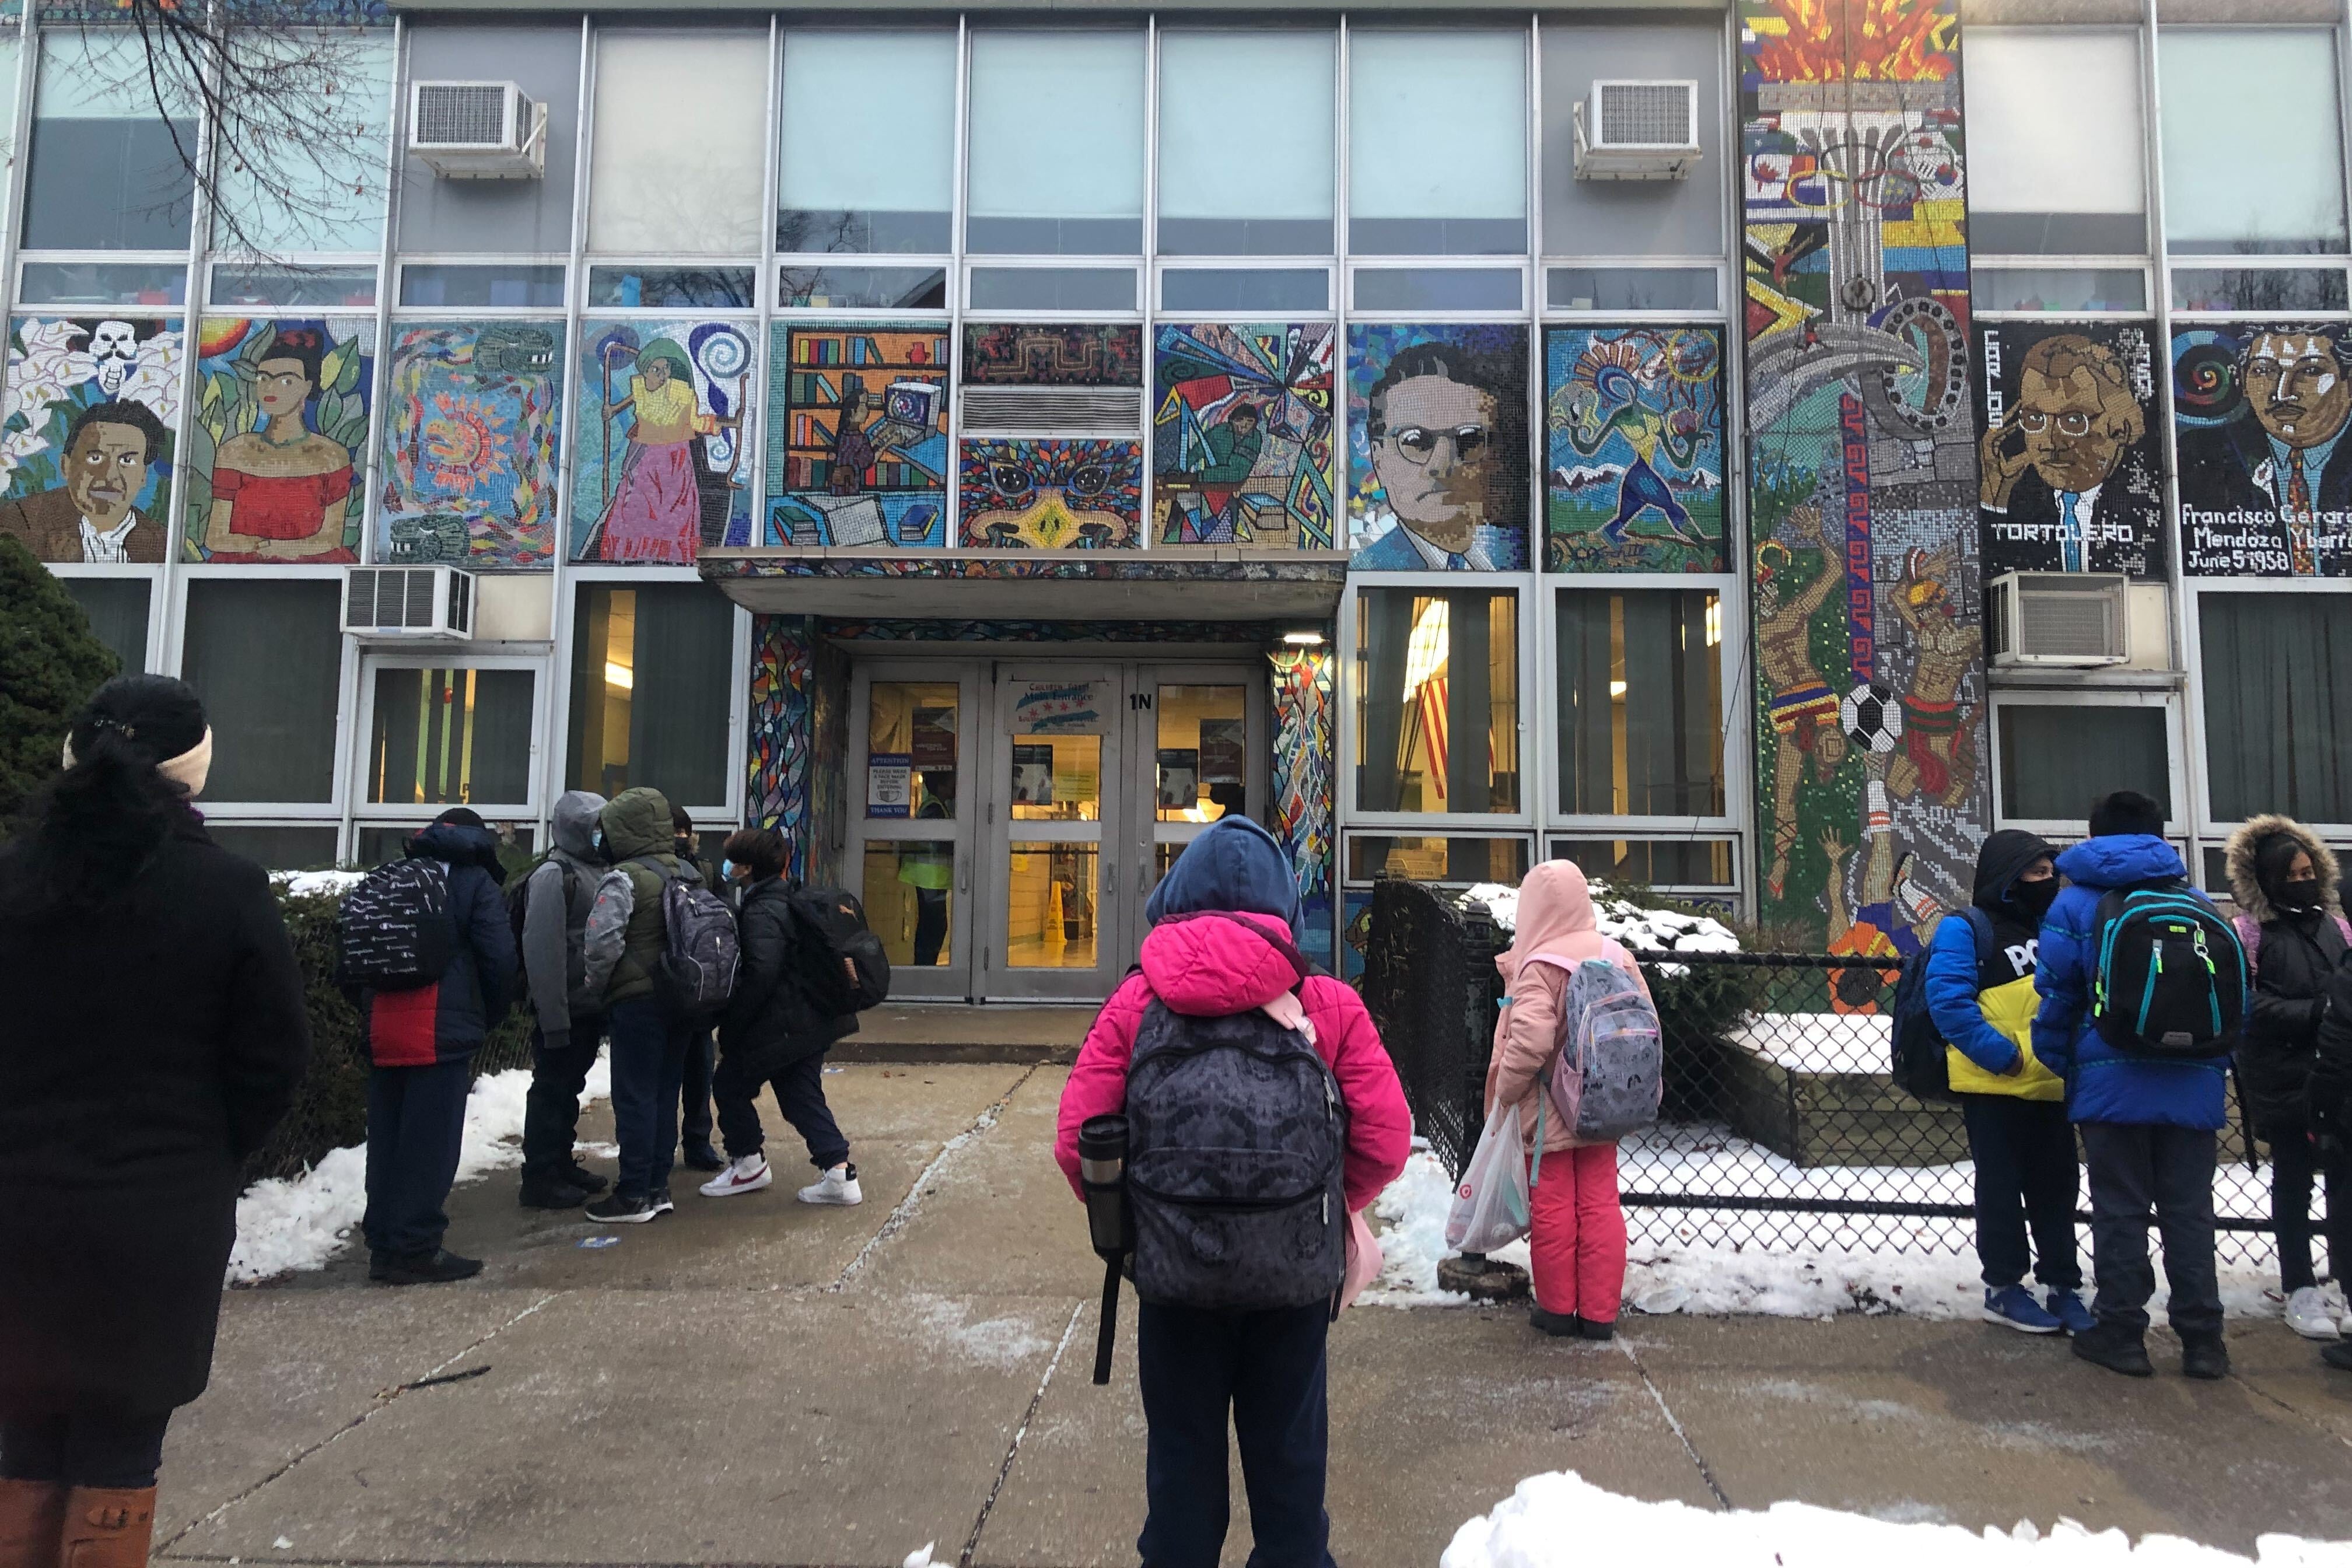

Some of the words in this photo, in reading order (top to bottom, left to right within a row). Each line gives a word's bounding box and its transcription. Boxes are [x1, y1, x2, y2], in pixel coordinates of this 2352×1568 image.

[1985, 330, 2003, 429] CARLOS
[2182, 503, 2276, 525] Francisco
[1990, 523, 2133, 542] TORTOLERO
[2193, 527, 2282, 549] Mendoza
[2290, 527, 2352, 549] Ybarr
[2189, 551, 2231, 568] June
[2249, 551, 2289, 570] 1958
[1053, 691, 1094, 701] Entrance
[1130, 694, 1152, 710] 1N
